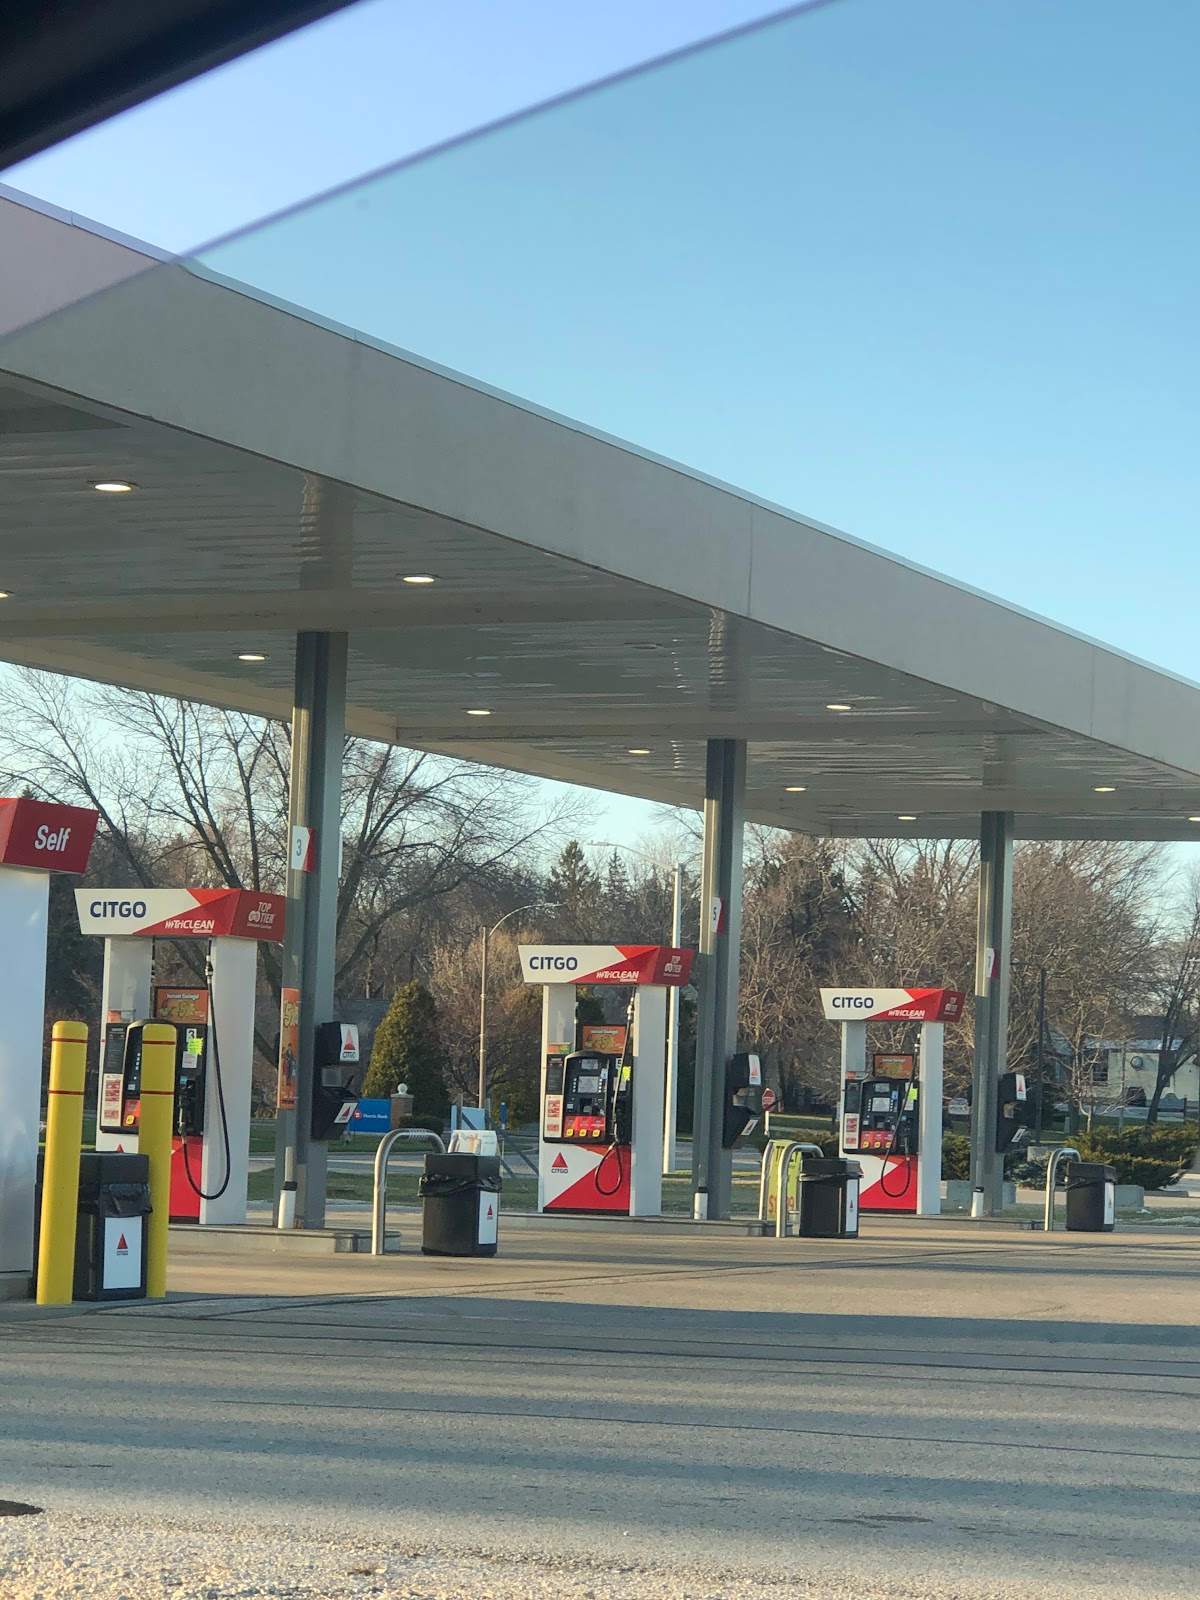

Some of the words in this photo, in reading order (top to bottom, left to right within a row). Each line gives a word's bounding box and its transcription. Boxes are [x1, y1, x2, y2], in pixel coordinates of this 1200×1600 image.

[35, 824, 71, 851] Self
[296, 838, 302, 857] 3
[90, 901, 146, 918] CITGO
[258, 901, 272, 912] TOP
[260, 912, 274, 923] TIER
[173, 920, 214, 929] TriCLEAN
[529, 957, 578, 970] CITGO
[832, 996, 874, 1008] CITGO
